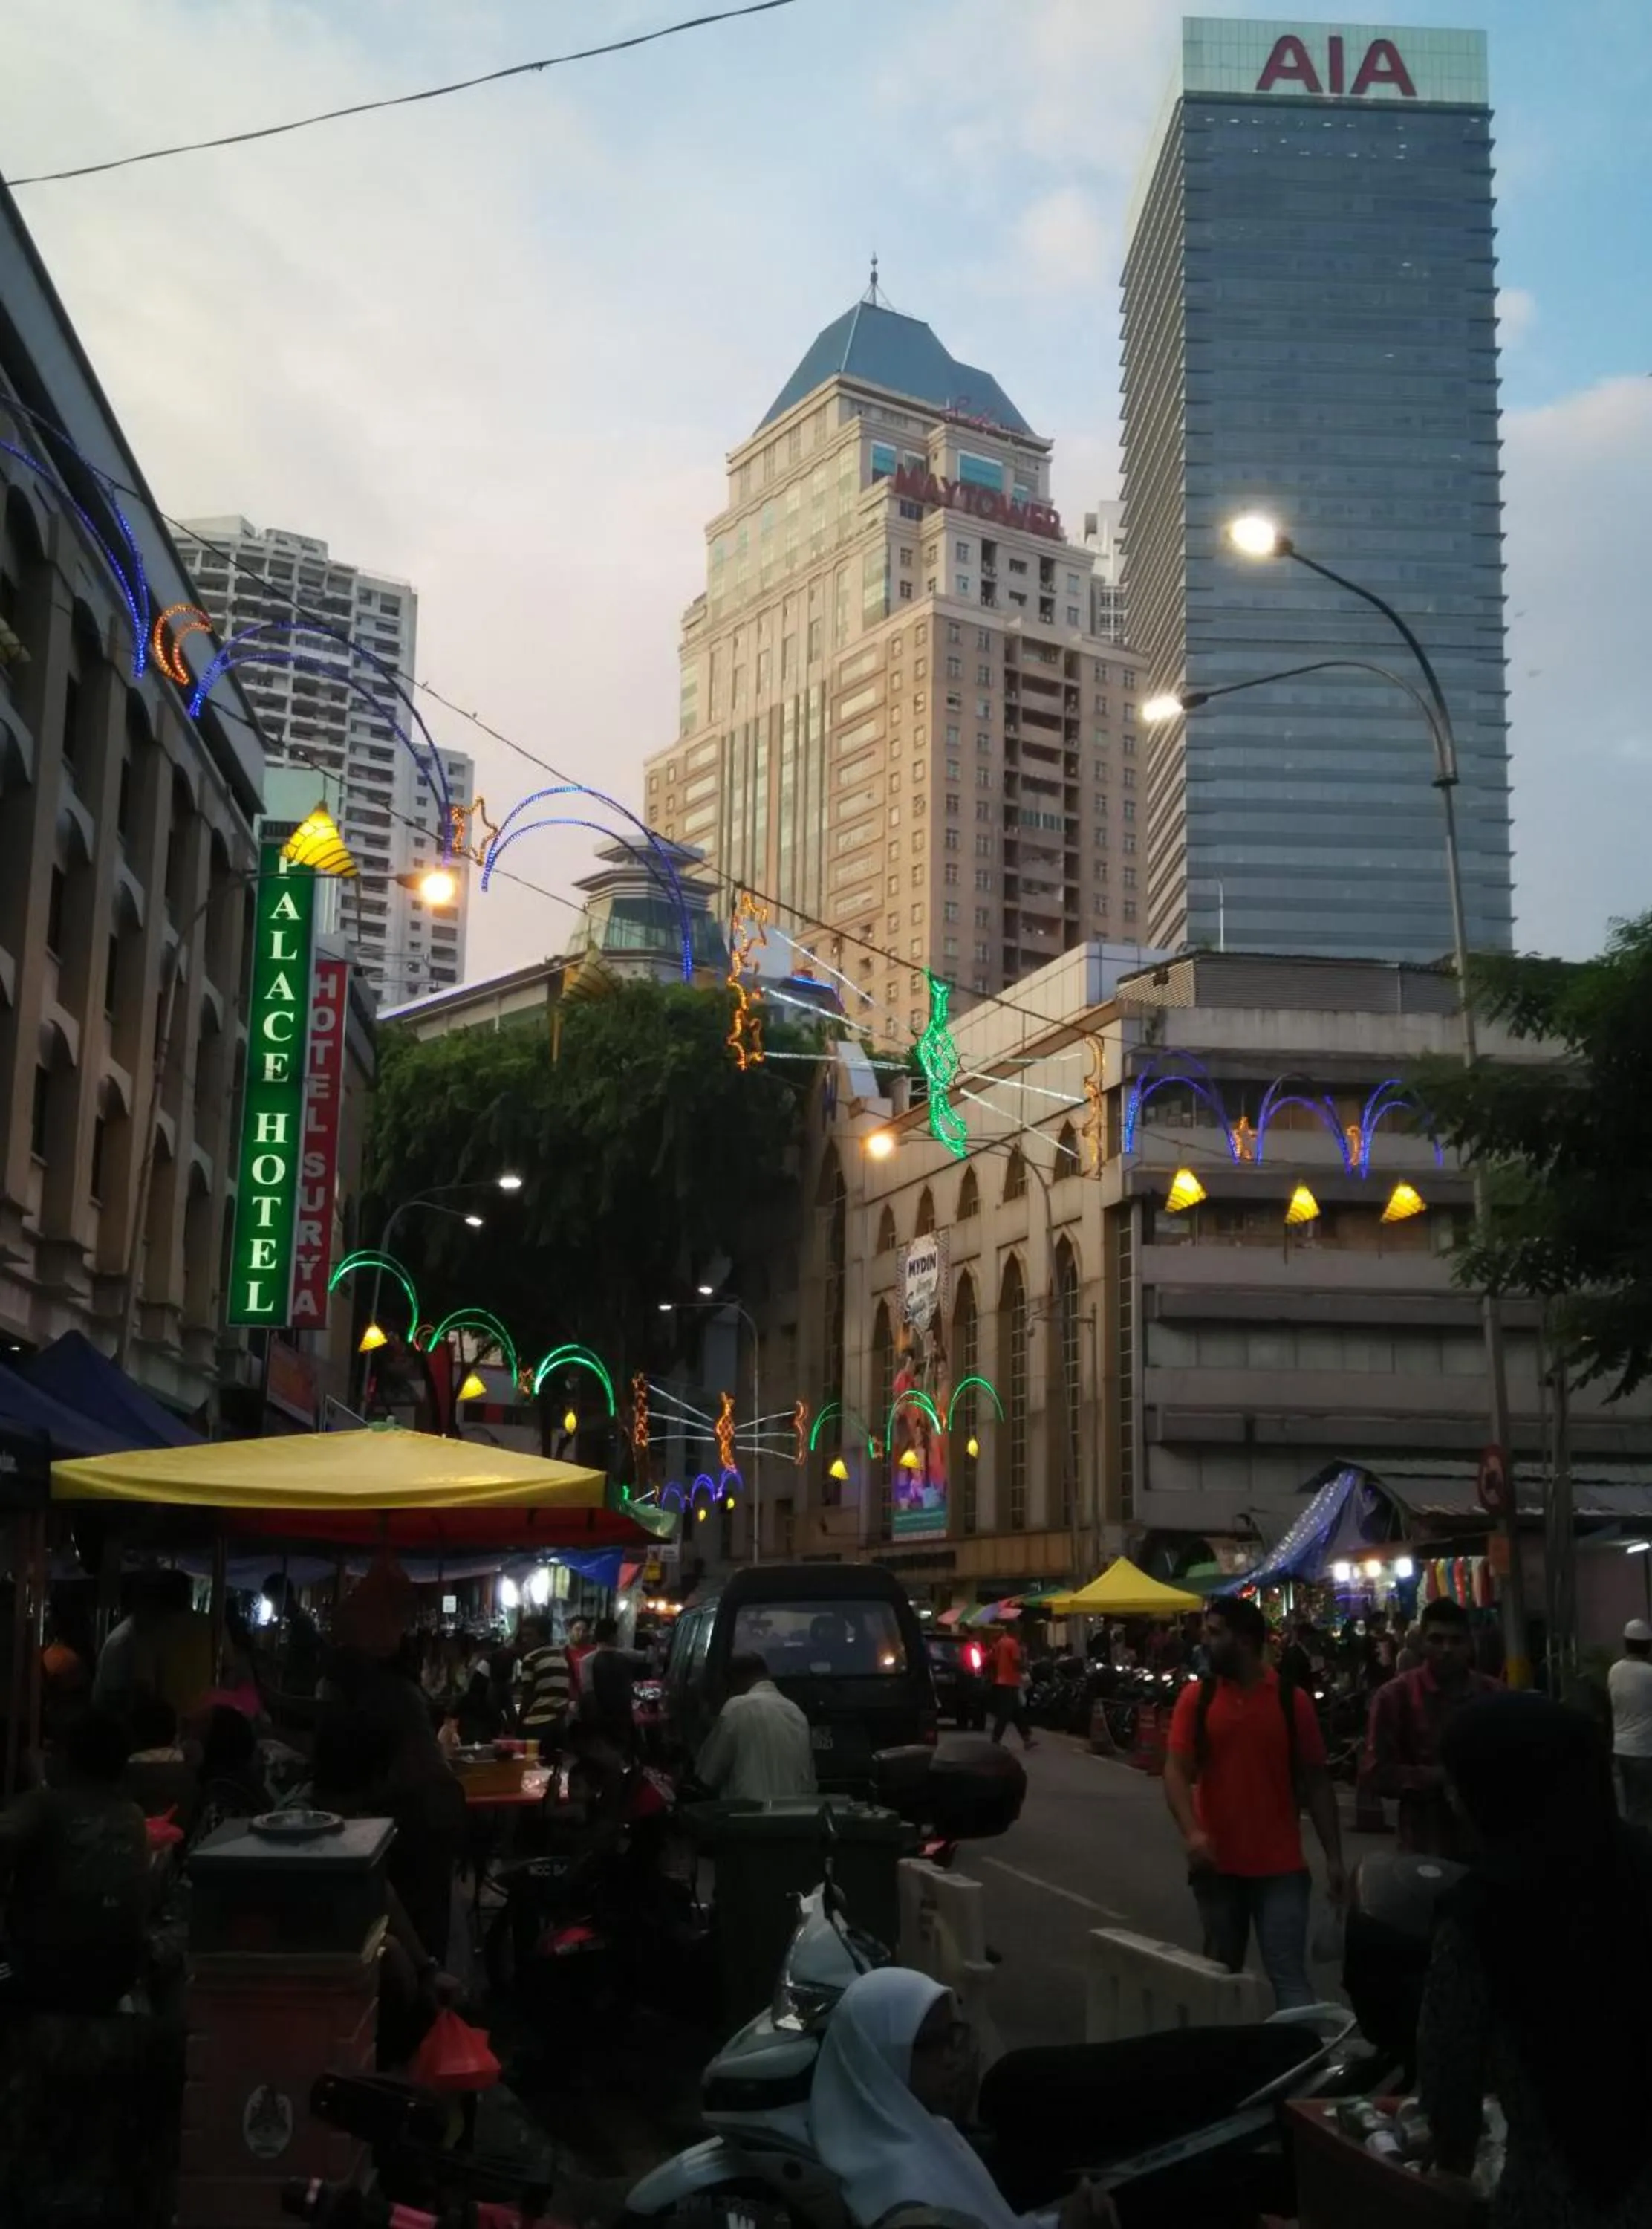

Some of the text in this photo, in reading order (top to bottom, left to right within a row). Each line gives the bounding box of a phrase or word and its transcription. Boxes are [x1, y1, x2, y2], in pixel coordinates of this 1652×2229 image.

[1255, 34, 1417, 97] AIA
[894, 463, 1064, 542] MAYTOWER
[294, 973, 337, 1316] HOTEL SURYA
[244, 1112, 290, 1312] HOTEL
[908, 1251, 937, 1277] MYDIN
